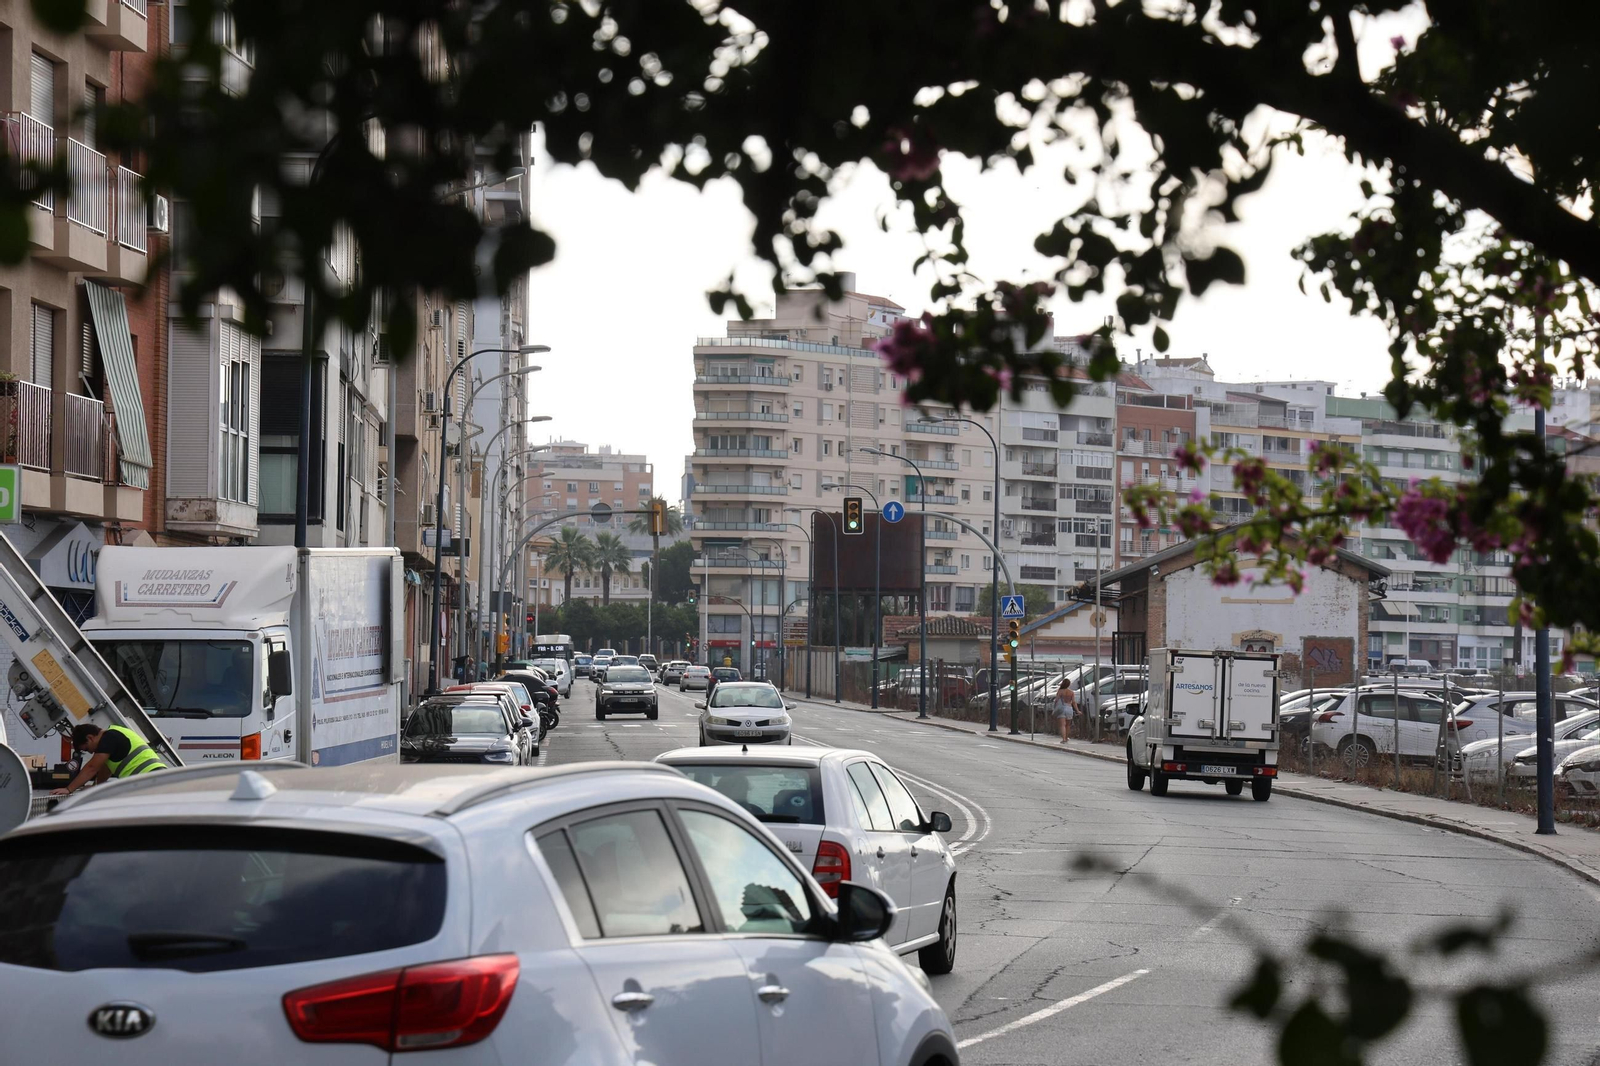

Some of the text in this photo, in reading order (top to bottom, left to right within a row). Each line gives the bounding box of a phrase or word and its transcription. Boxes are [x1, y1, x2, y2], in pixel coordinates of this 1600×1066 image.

[142, 569, 214, 581] MUDANZAS
[137, 583, 211, 597] CARRETERO
[97, 1009, 142, 1031] KIA
